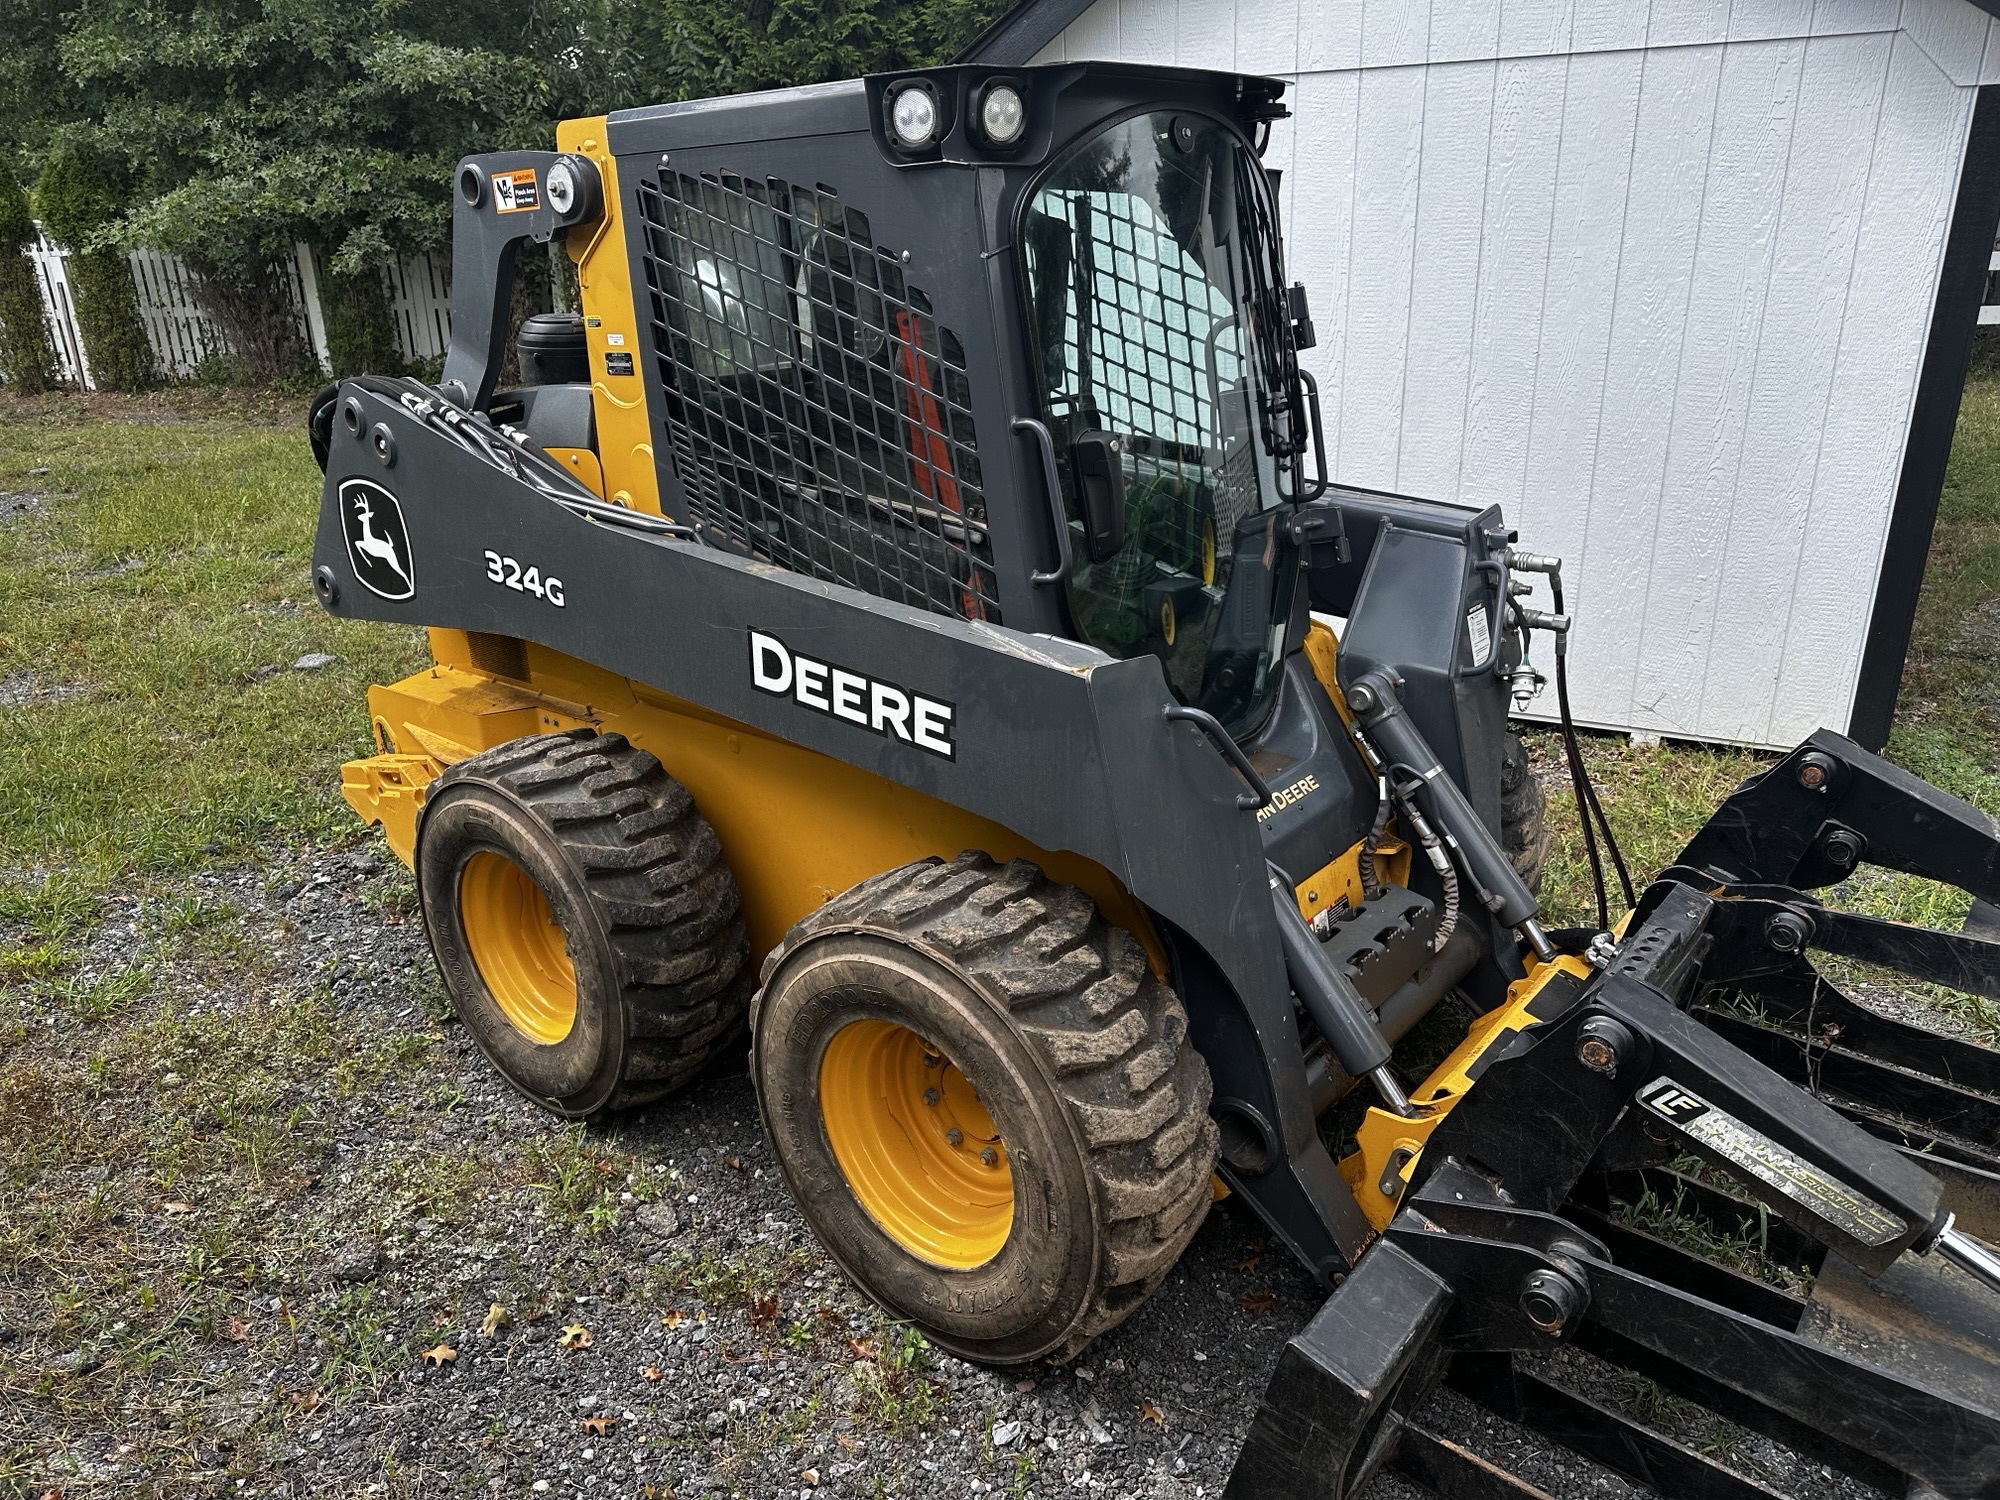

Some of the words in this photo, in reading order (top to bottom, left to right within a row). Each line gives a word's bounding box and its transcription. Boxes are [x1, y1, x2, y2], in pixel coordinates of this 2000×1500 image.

[484, 549, 565, 607] 324G
[751, 631, 952, 756] DEERE
[1271, 774, 1320, 811] DEERE
